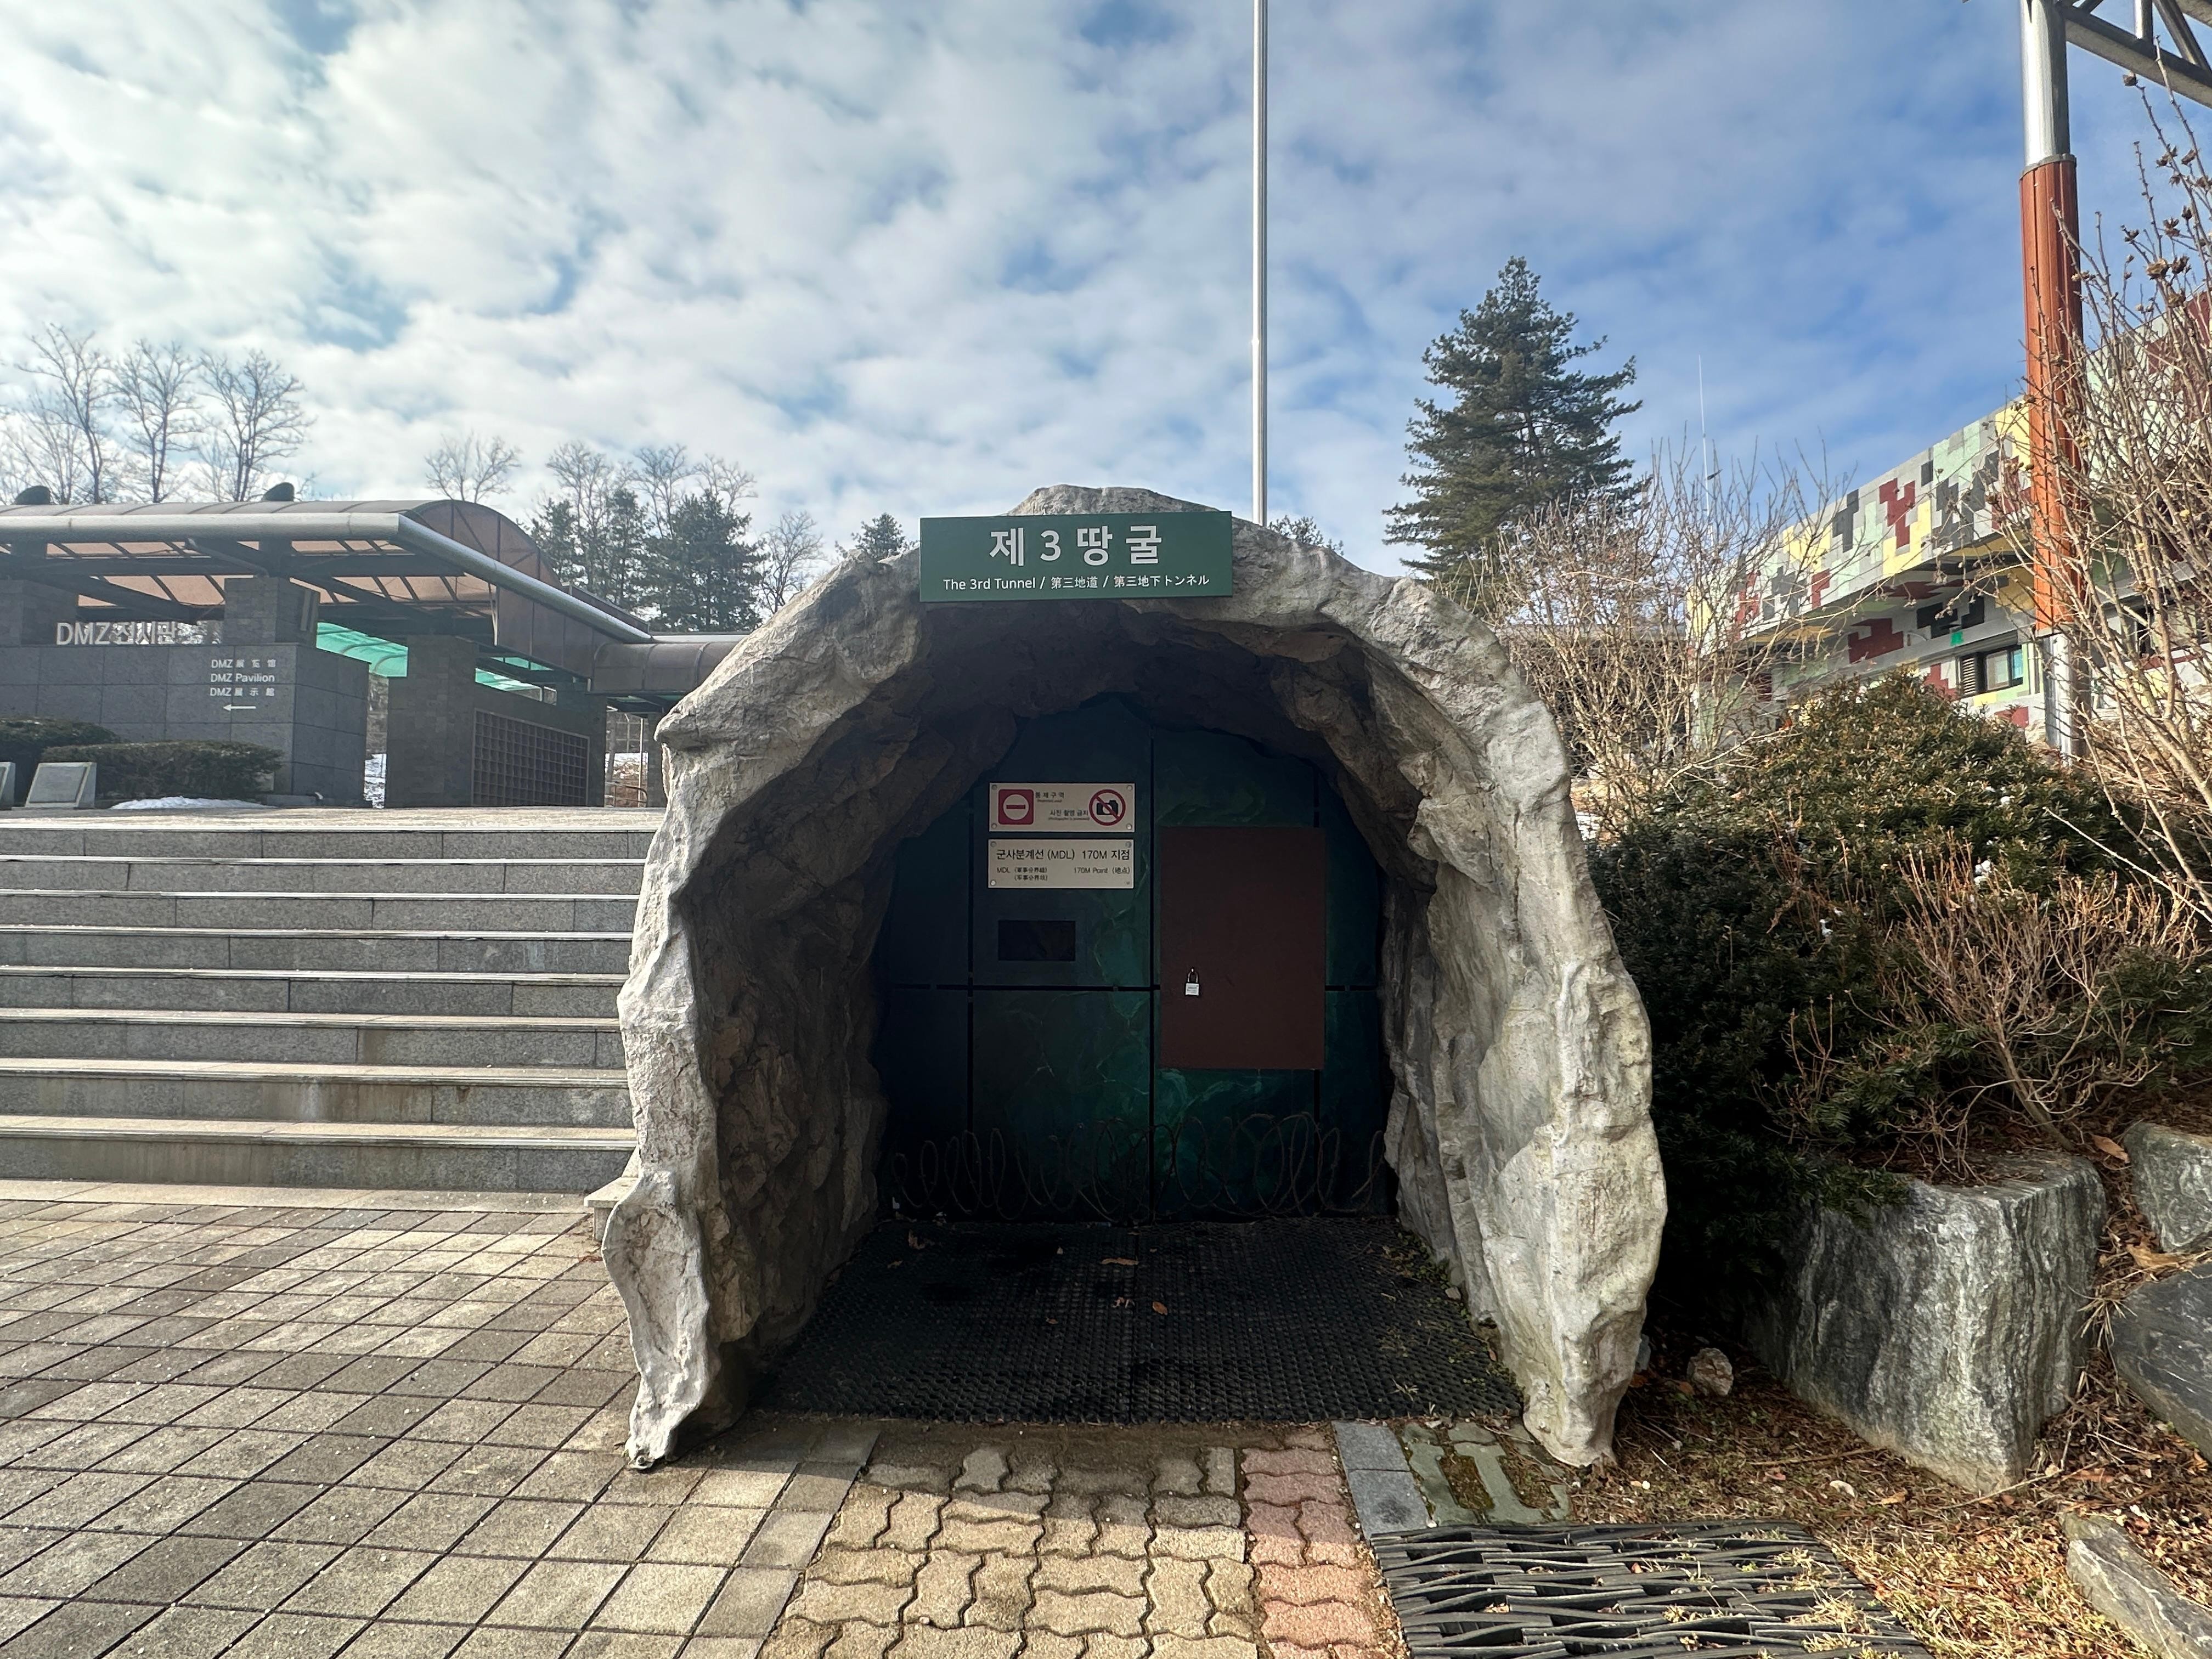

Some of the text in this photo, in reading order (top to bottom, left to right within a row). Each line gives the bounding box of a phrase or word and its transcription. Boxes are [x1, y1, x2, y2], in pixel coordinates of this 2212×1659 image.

[989, 527, 1024, 567] 제
[1040, 530, 1062, 561] 3
[943, 578, 966, 590] The
[970, 578, 991, 590] 3rd
[994, 577, 1036, 589] Tunnel
[1051, 576, 1098, 589] 第三地道
[1114, 575, 1210, 588] 第三地下トンネル
[211, 659, 233, 668] DMZ
[211, 673, 275, 682] DMZ Pavilion
[210, 687, 232, 696] DMZ
[996, 849, 1130, 860] 군사분계선 (MDL) 170M 지점
